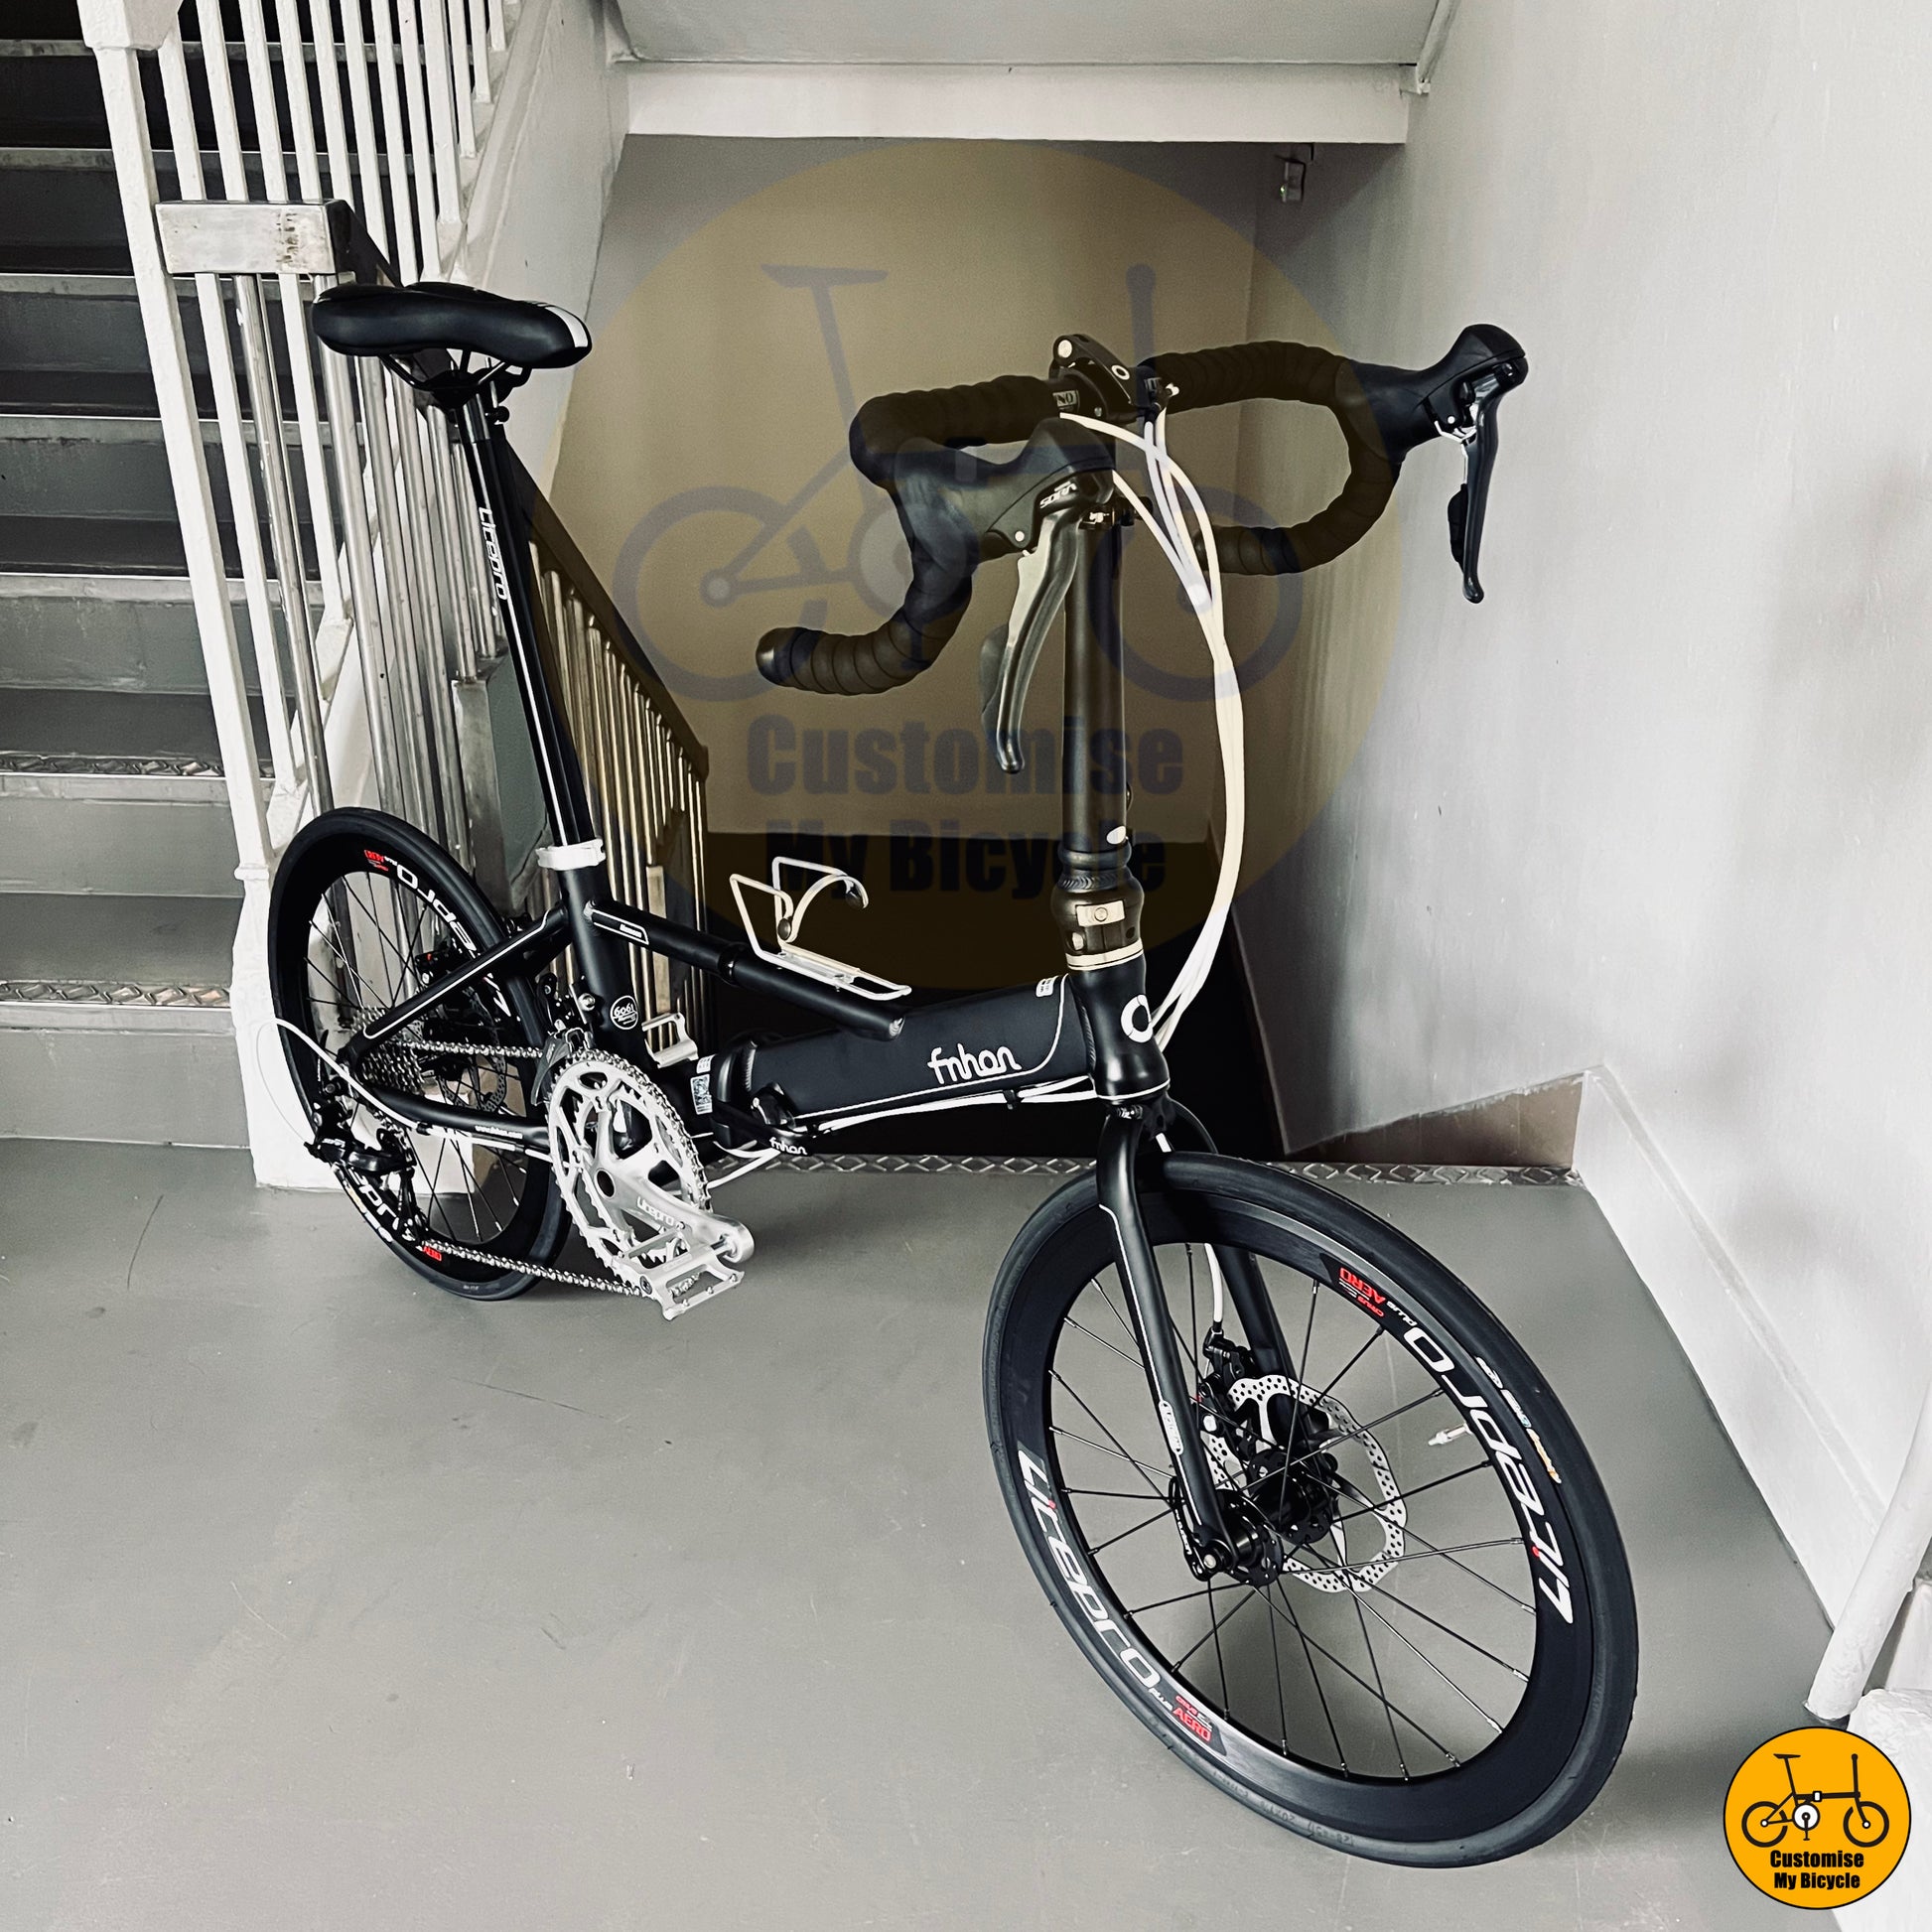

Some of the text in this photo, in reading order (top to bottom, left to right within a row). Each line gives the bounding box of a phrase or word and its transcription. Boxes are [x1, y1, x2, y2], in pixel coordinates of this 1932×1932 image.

[614, 1002, 635, 1017] 6061
[927, 1042, 1023, 1084] fnhon
[1339, 1267, 1387, 1304] AERO
[1173, 1707, 1212, 1742] AERO
